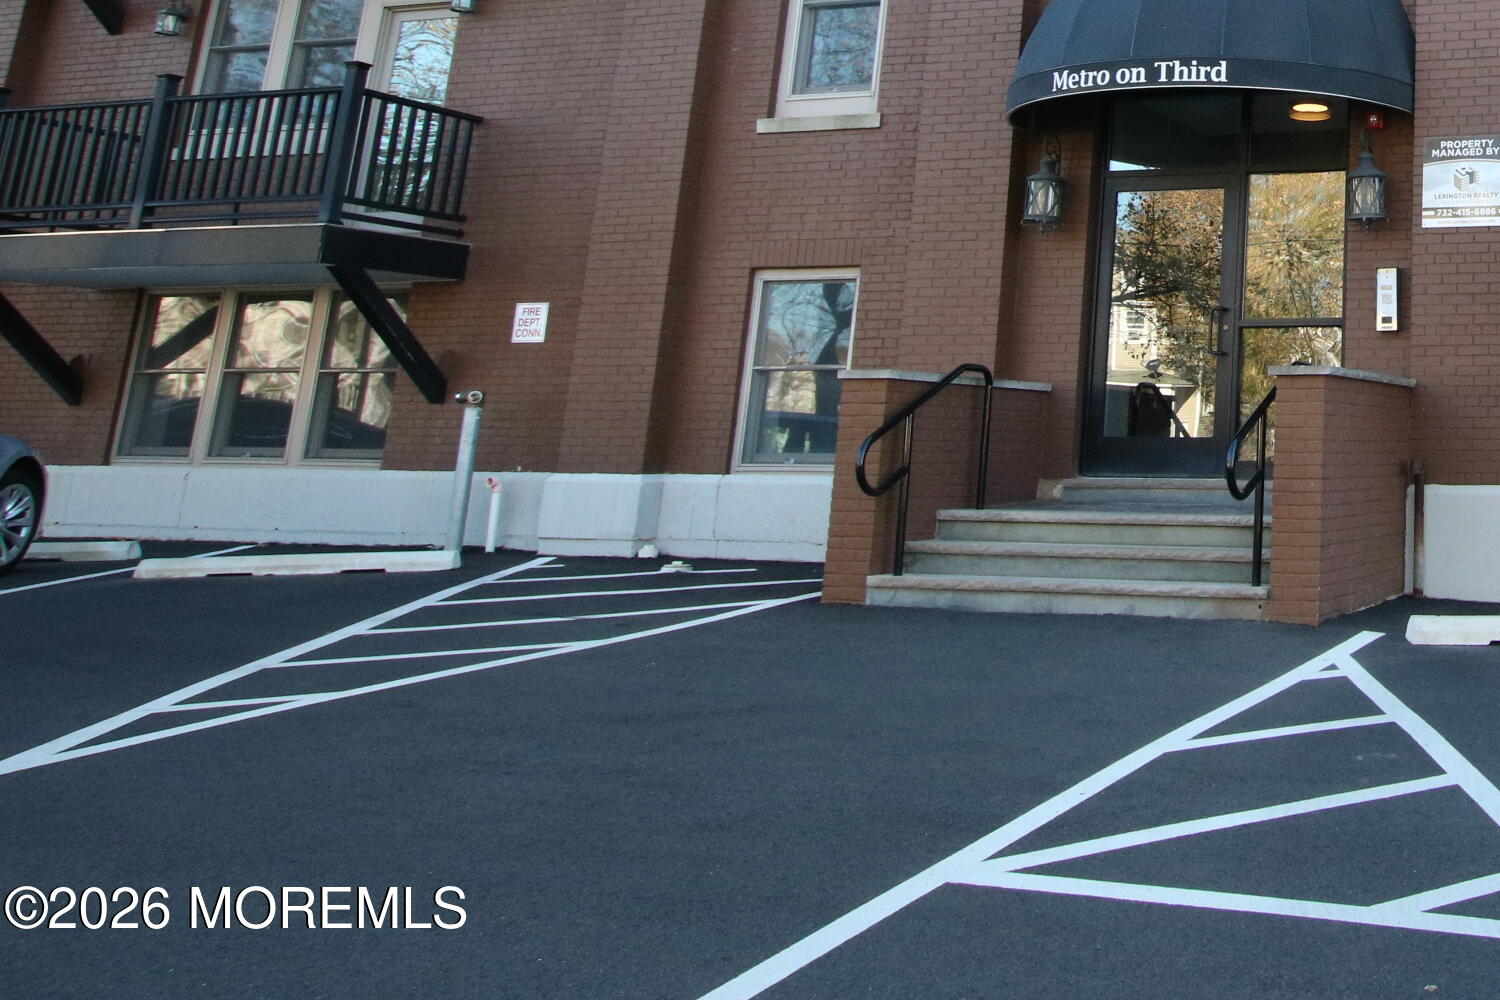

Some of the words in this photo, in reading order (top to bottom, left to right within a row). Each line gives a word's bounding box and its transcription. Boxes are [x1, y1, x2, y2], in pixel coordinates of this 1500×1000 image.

[1052, 68, 1110, 91] Metro
[1115, 66, 1147, 84] on
[1154, 60, 1228, 83] Third
[1440, 139, 1494, 149] PROPERTY
[1431, 148, 1483, 158] MANAGED
[1434, 192, 1472, 200] LEXINGTON
[1473, 191, 1499, 199] REALTY
[522, 307, 541, 317] FIRE
